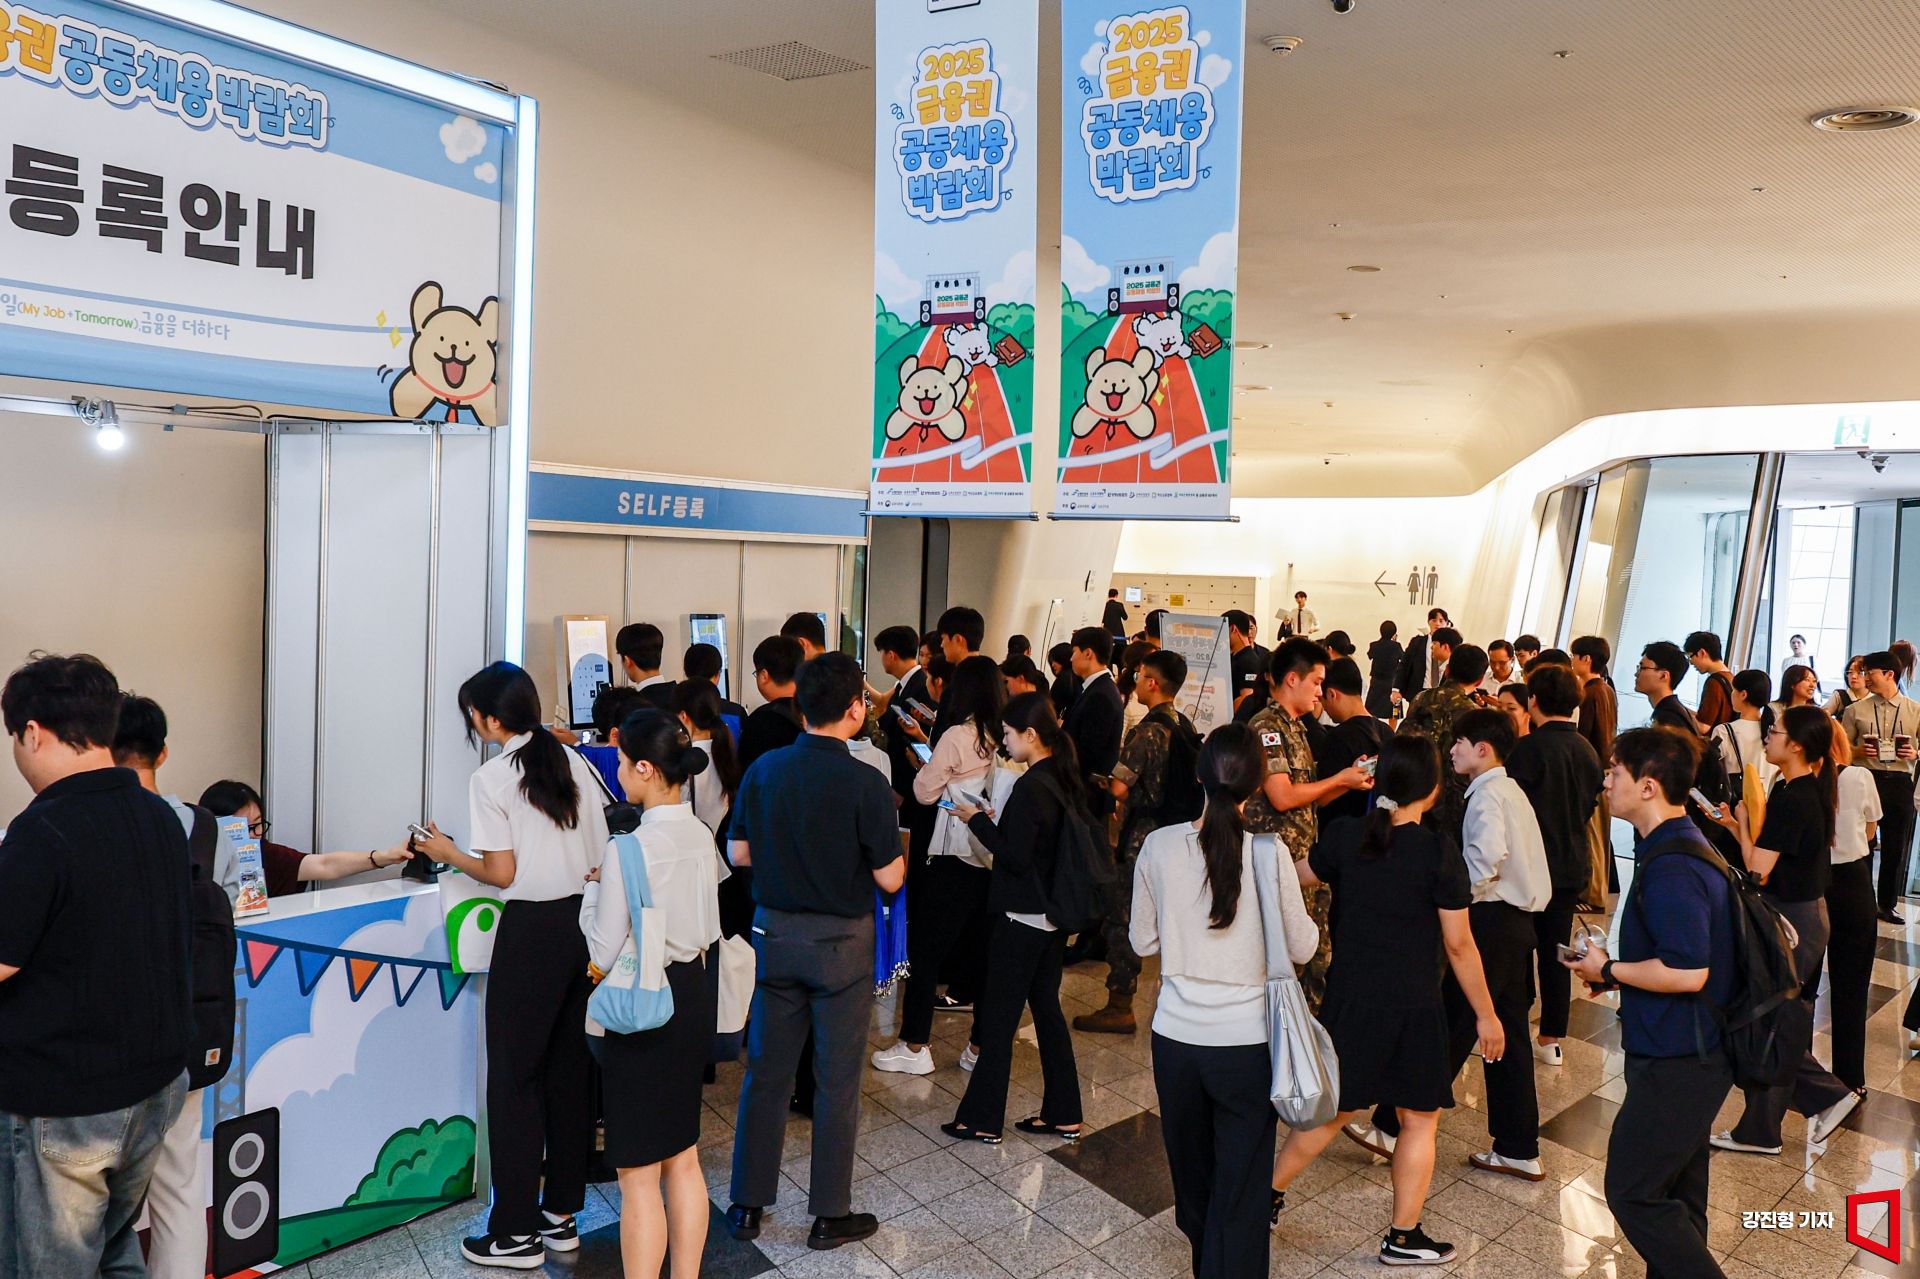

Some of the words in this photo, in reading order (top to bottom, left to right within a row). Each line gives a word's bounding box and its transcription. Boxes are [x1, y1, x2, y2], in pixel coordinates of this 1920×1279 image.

[1114, 16, 1183, 52] 2025
[924, 48, 985, 82] 2025
[1107, 48, 1191, 99] 금융권
[917, 79, 992, 125] 금융권
[1088, 92, 1208, 149] 공동채용
[900, 119, 1008, 171] 공동채용
[1096, 142, 1191, 193] 박람회
[5, 143, 315, 279] 등록안내
[908, 166, 994, 212] 박람회
[182, 319, 230, 340] 더하다
[617, 491, 704, 519] SELF등록
